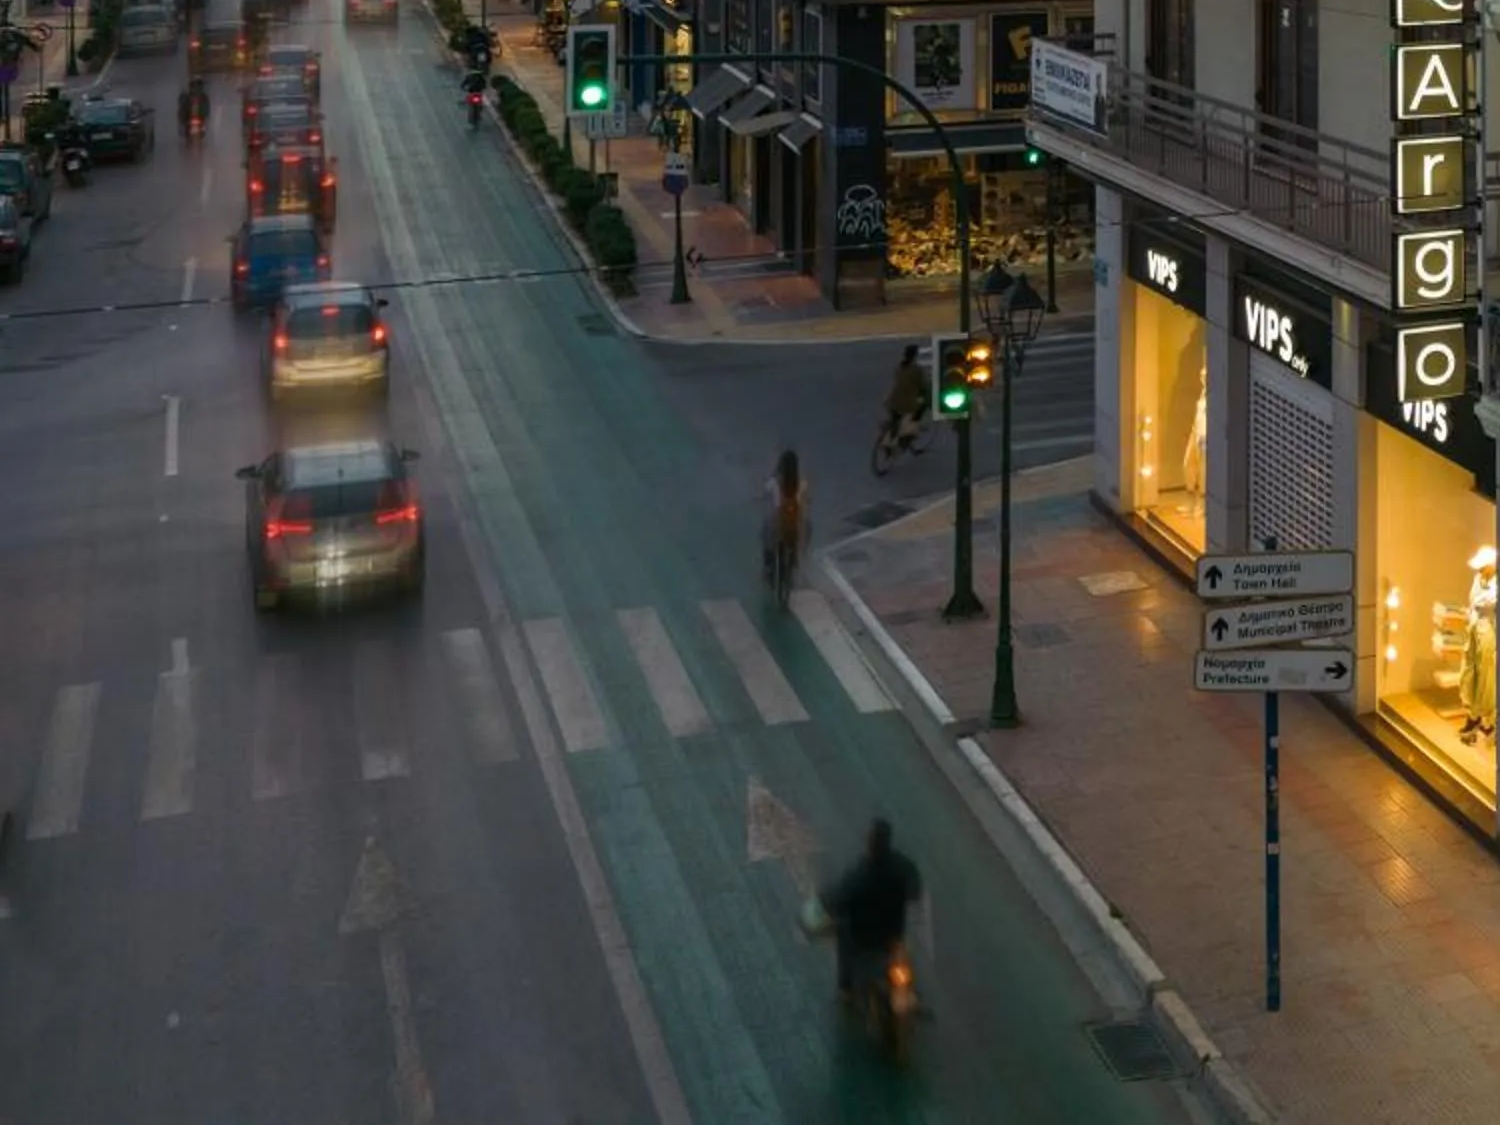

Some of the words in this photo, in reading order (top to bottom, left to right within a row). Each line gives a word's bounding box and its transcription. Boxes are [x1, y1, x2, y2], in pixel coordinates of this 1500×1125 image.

[1408, 53, 1460, 386] Argo
[1147, 249, 1178, 293] VIPS
[1245, 296, 1293, 363] VIPS
[1233, 579, 1267, 590] Town
[1271, 577, 1297, 588] Hall
[1238, 623, 1297, 639] Municipal
[1203, 672, 1269, 684] Prefecture
